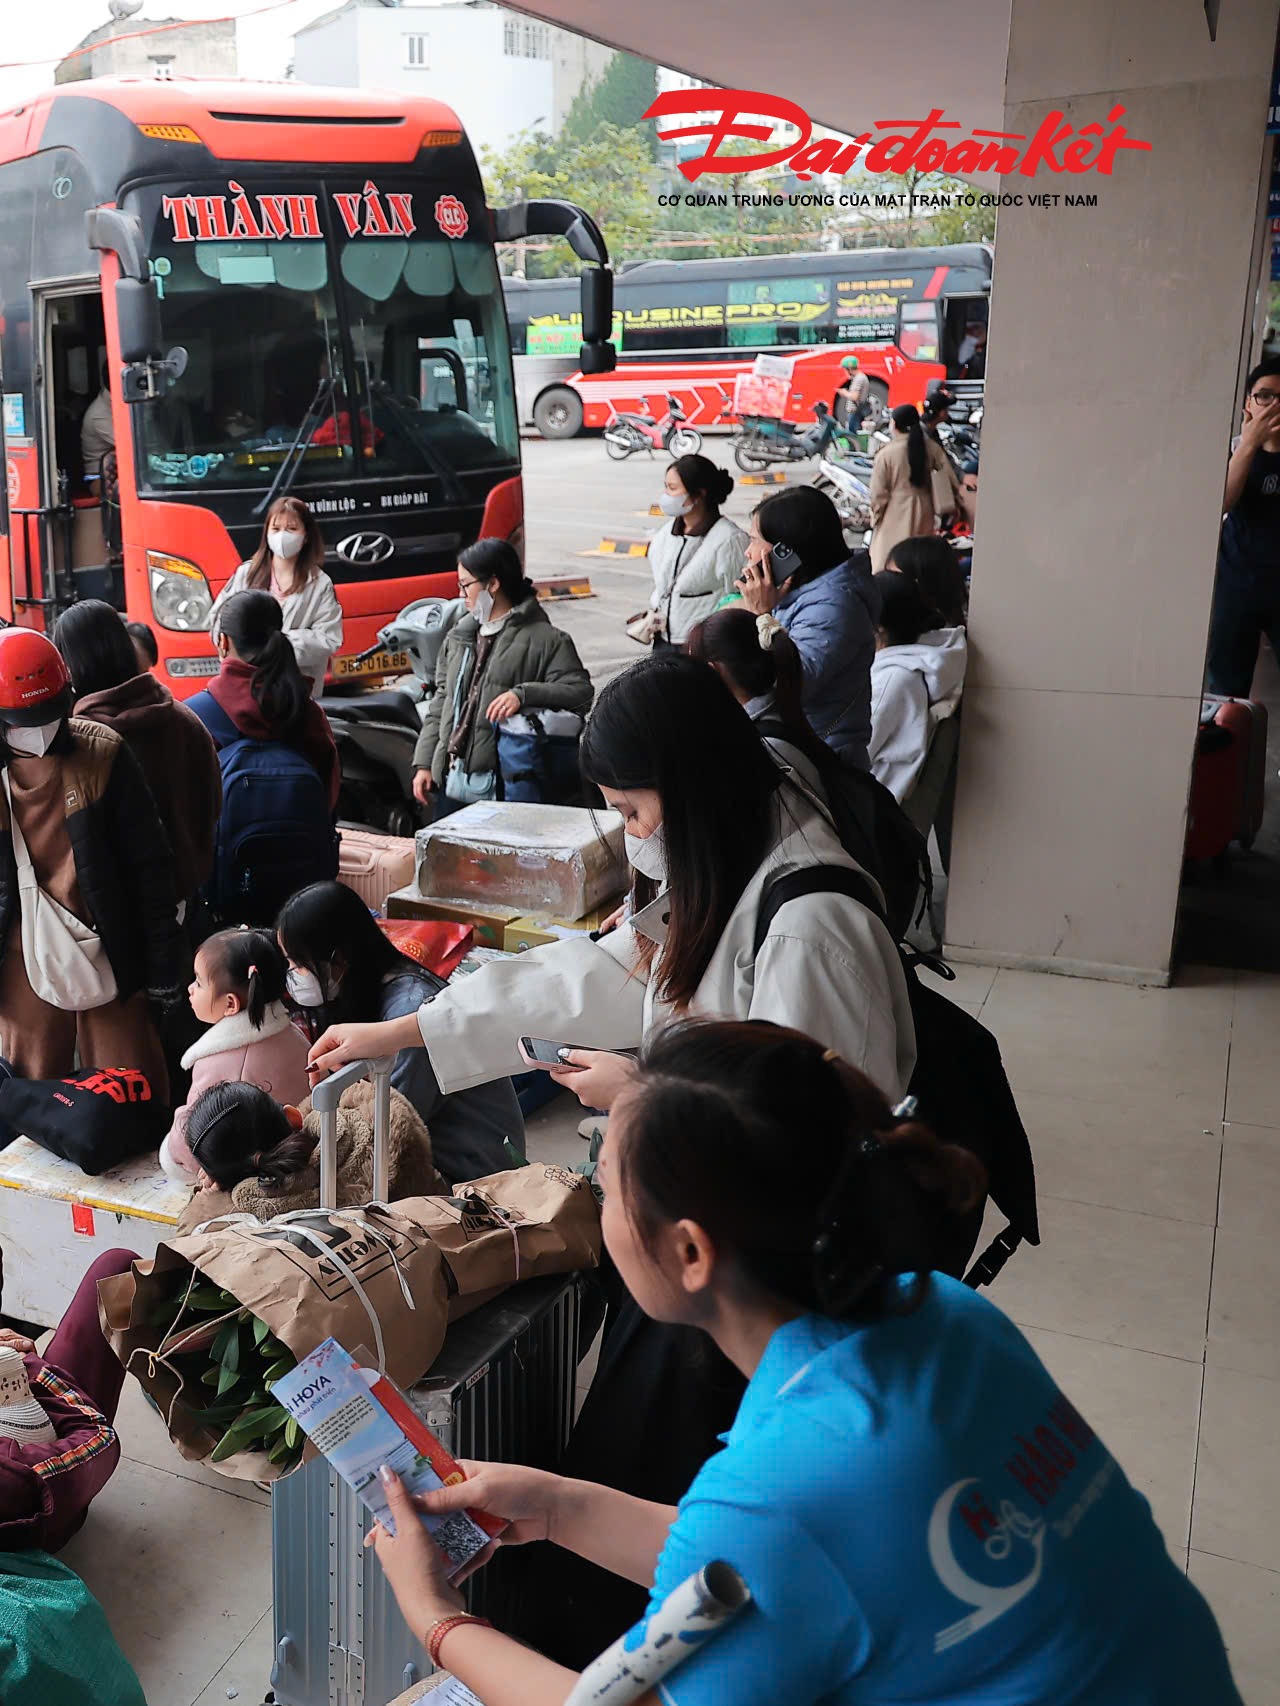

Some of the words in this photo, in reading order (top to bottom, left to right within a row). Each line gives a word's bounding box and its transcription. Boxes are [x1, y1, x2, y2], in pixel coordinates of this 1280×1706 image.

[162, 179, 324, 243] THÀNH
[332, 179, 417, 239] VÂN
[552, 304, 725, 326] LIUSINE
[726, 303, 803, 318] PRO
[21, 687, 49, 699] HONDA
[291, 1375, 332, 1408] HOYA
